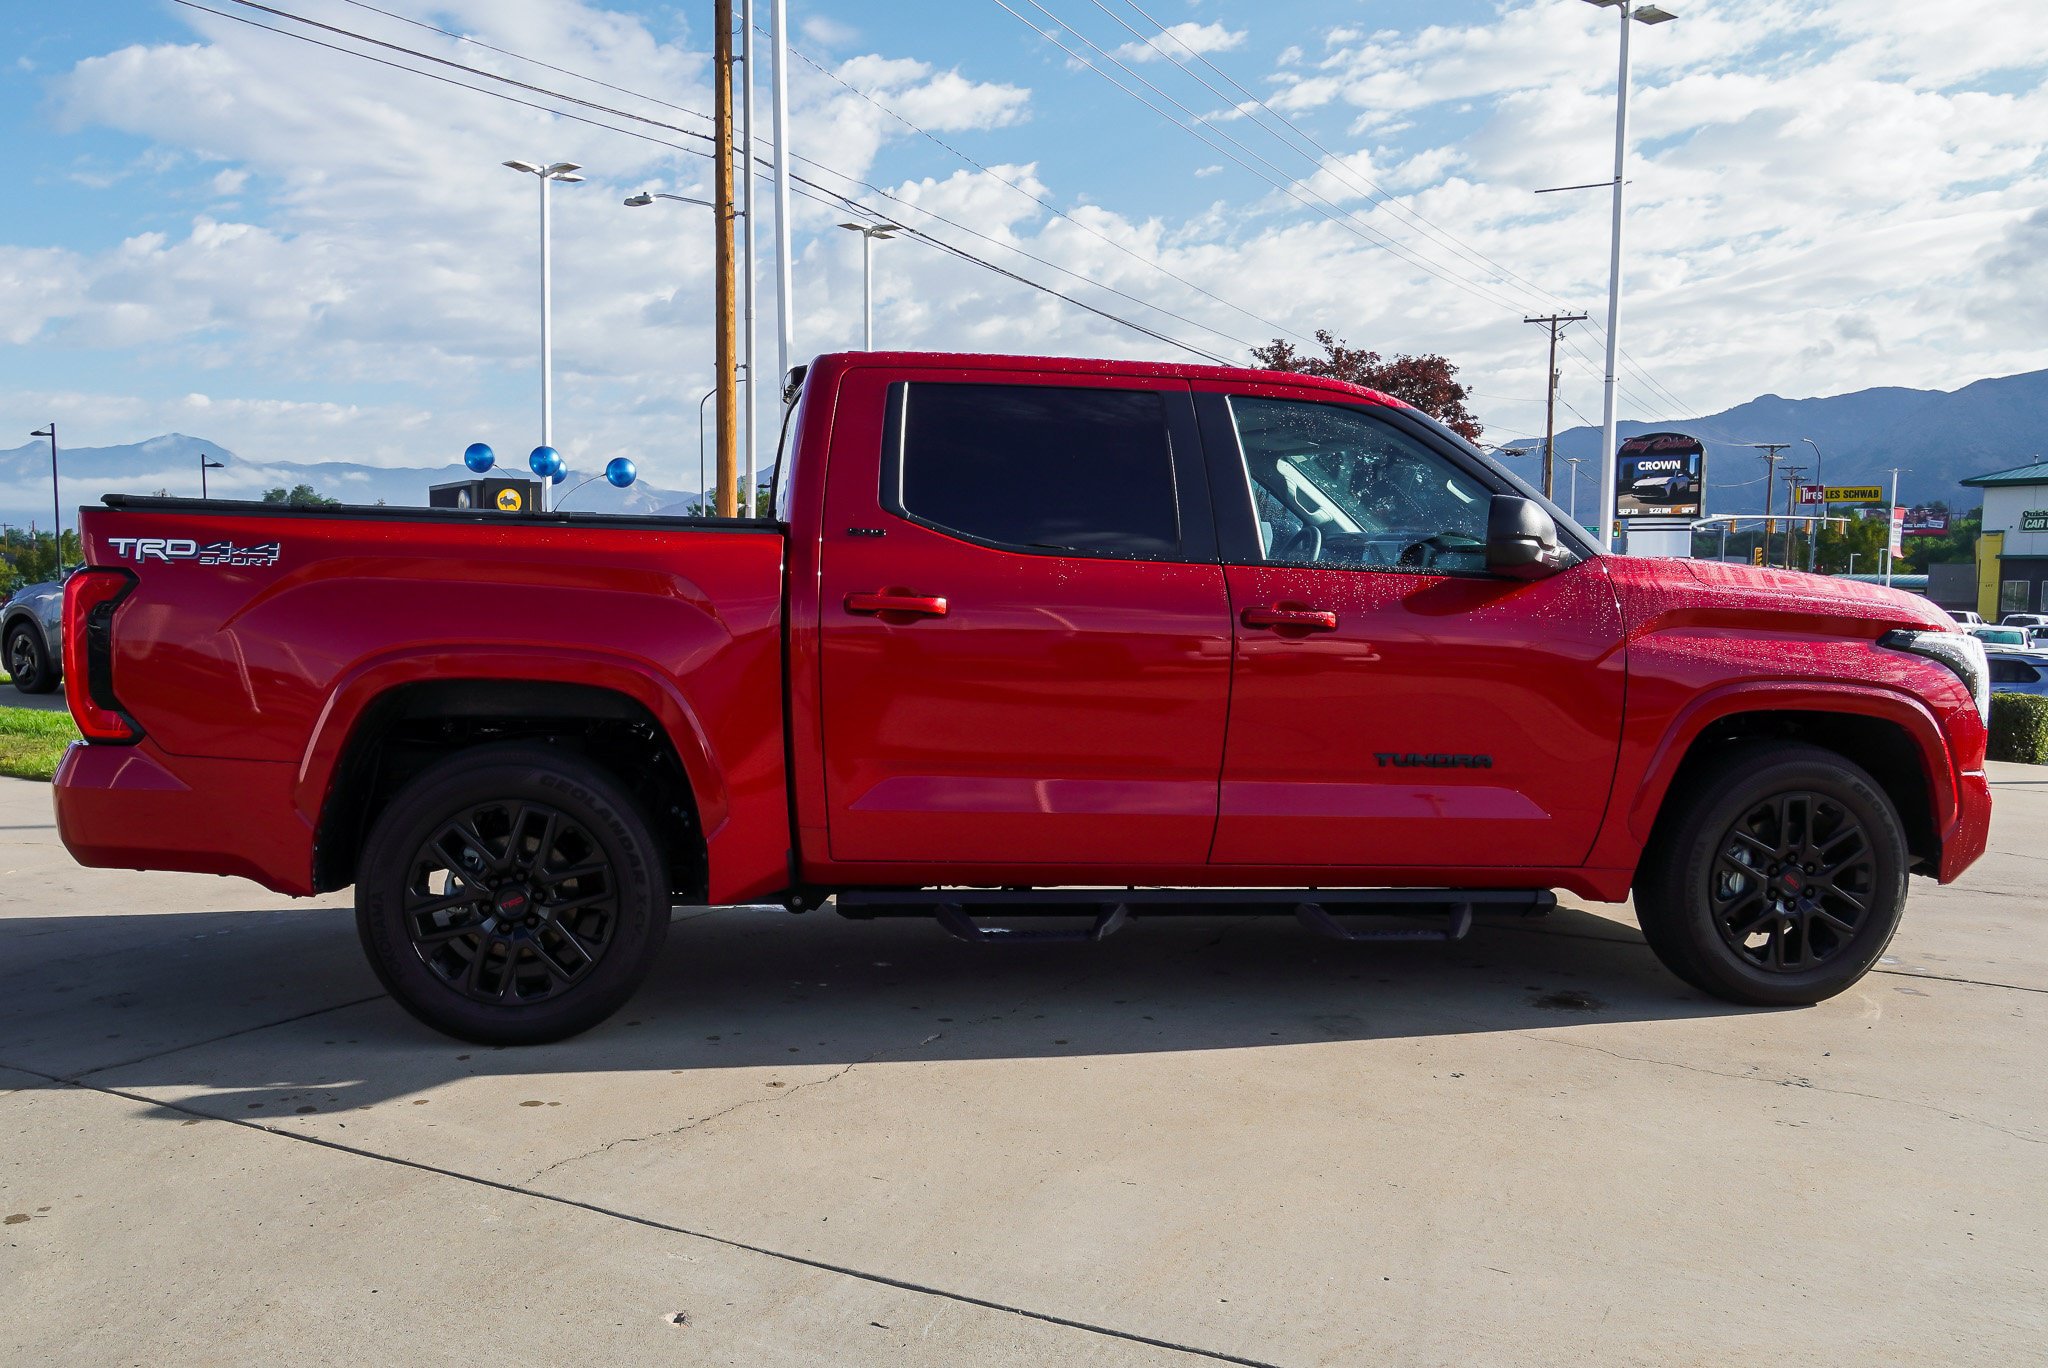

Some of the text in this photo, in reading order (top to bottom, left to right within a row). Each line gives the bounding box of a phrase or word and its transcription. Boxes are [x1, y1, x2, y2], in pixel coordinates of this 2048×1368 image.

[1637, 460, 1681, 471] CROWN
[1801, 487, 1823, 503] Tires
[1825, 489, 1879, 499] LES SCHWAB
[2025, 519, 2046, 529] CAR
[108, 538, 200, 564] TRD
[199, 556, 280, 567] SPORT
[1373, 752, 1493, 769] TUNDRA
[540, 774, 647, 886] GEOLANDAR
